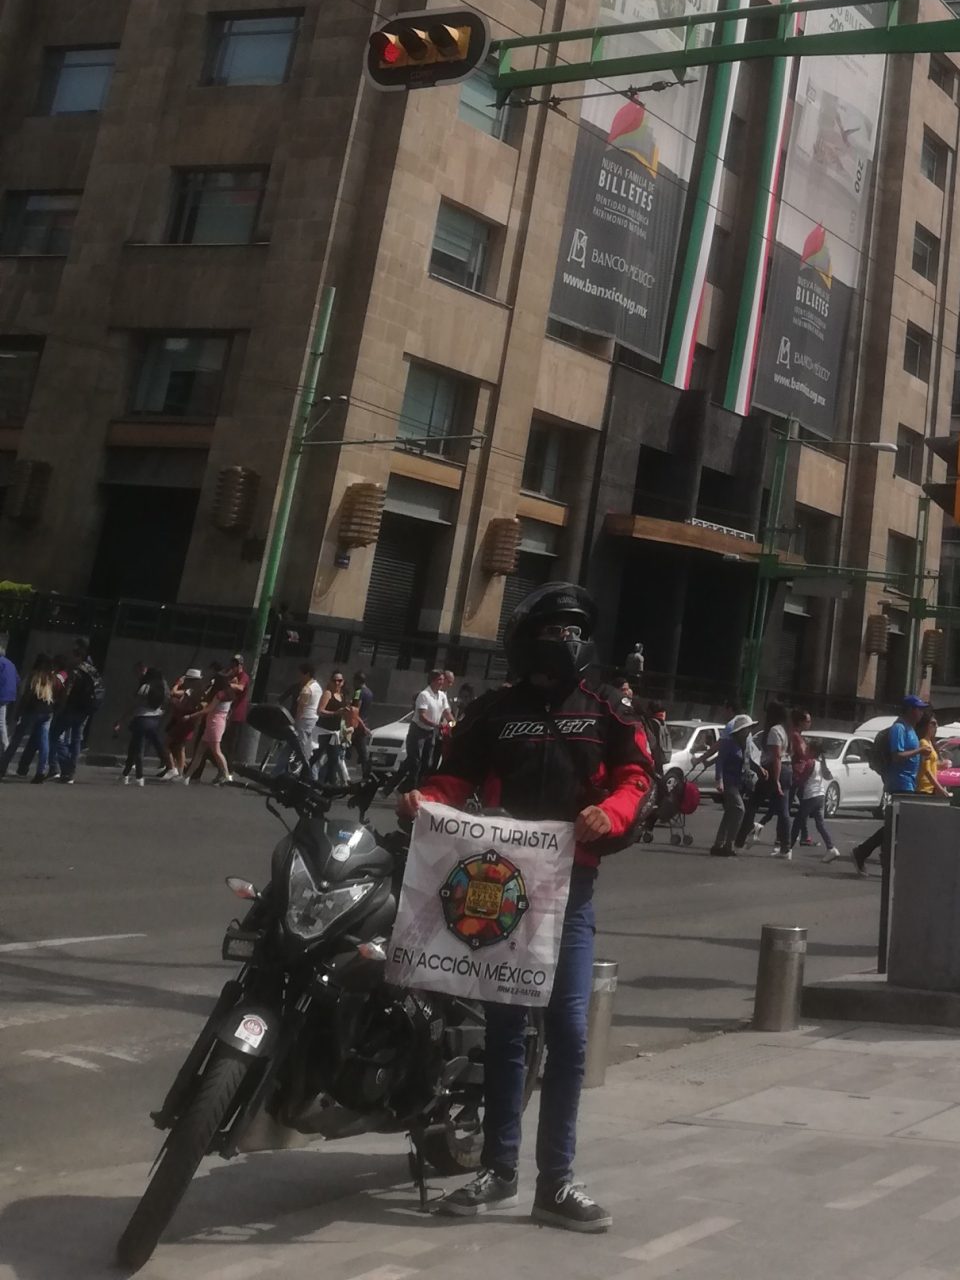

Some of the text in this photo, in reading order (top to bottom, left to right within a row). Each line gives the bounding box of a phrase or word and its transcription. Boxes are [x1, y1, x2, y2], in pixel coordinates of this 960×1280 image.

[602, 156, 623, 177] NUEVA
[854, 159, 865, 195] 200
[598, 169, 653, 212] BILLETES
[591, 248, 626, 273] BANCO
[795, 286, 829, 318] BILLETES
[429, 815, 559, 851] MOTO TURISTA
[487, 853, 497, 862] N
[518, 901, 528, 909] E
[392, 947, 546, 986] EN ACCIÓN MÉXICO
